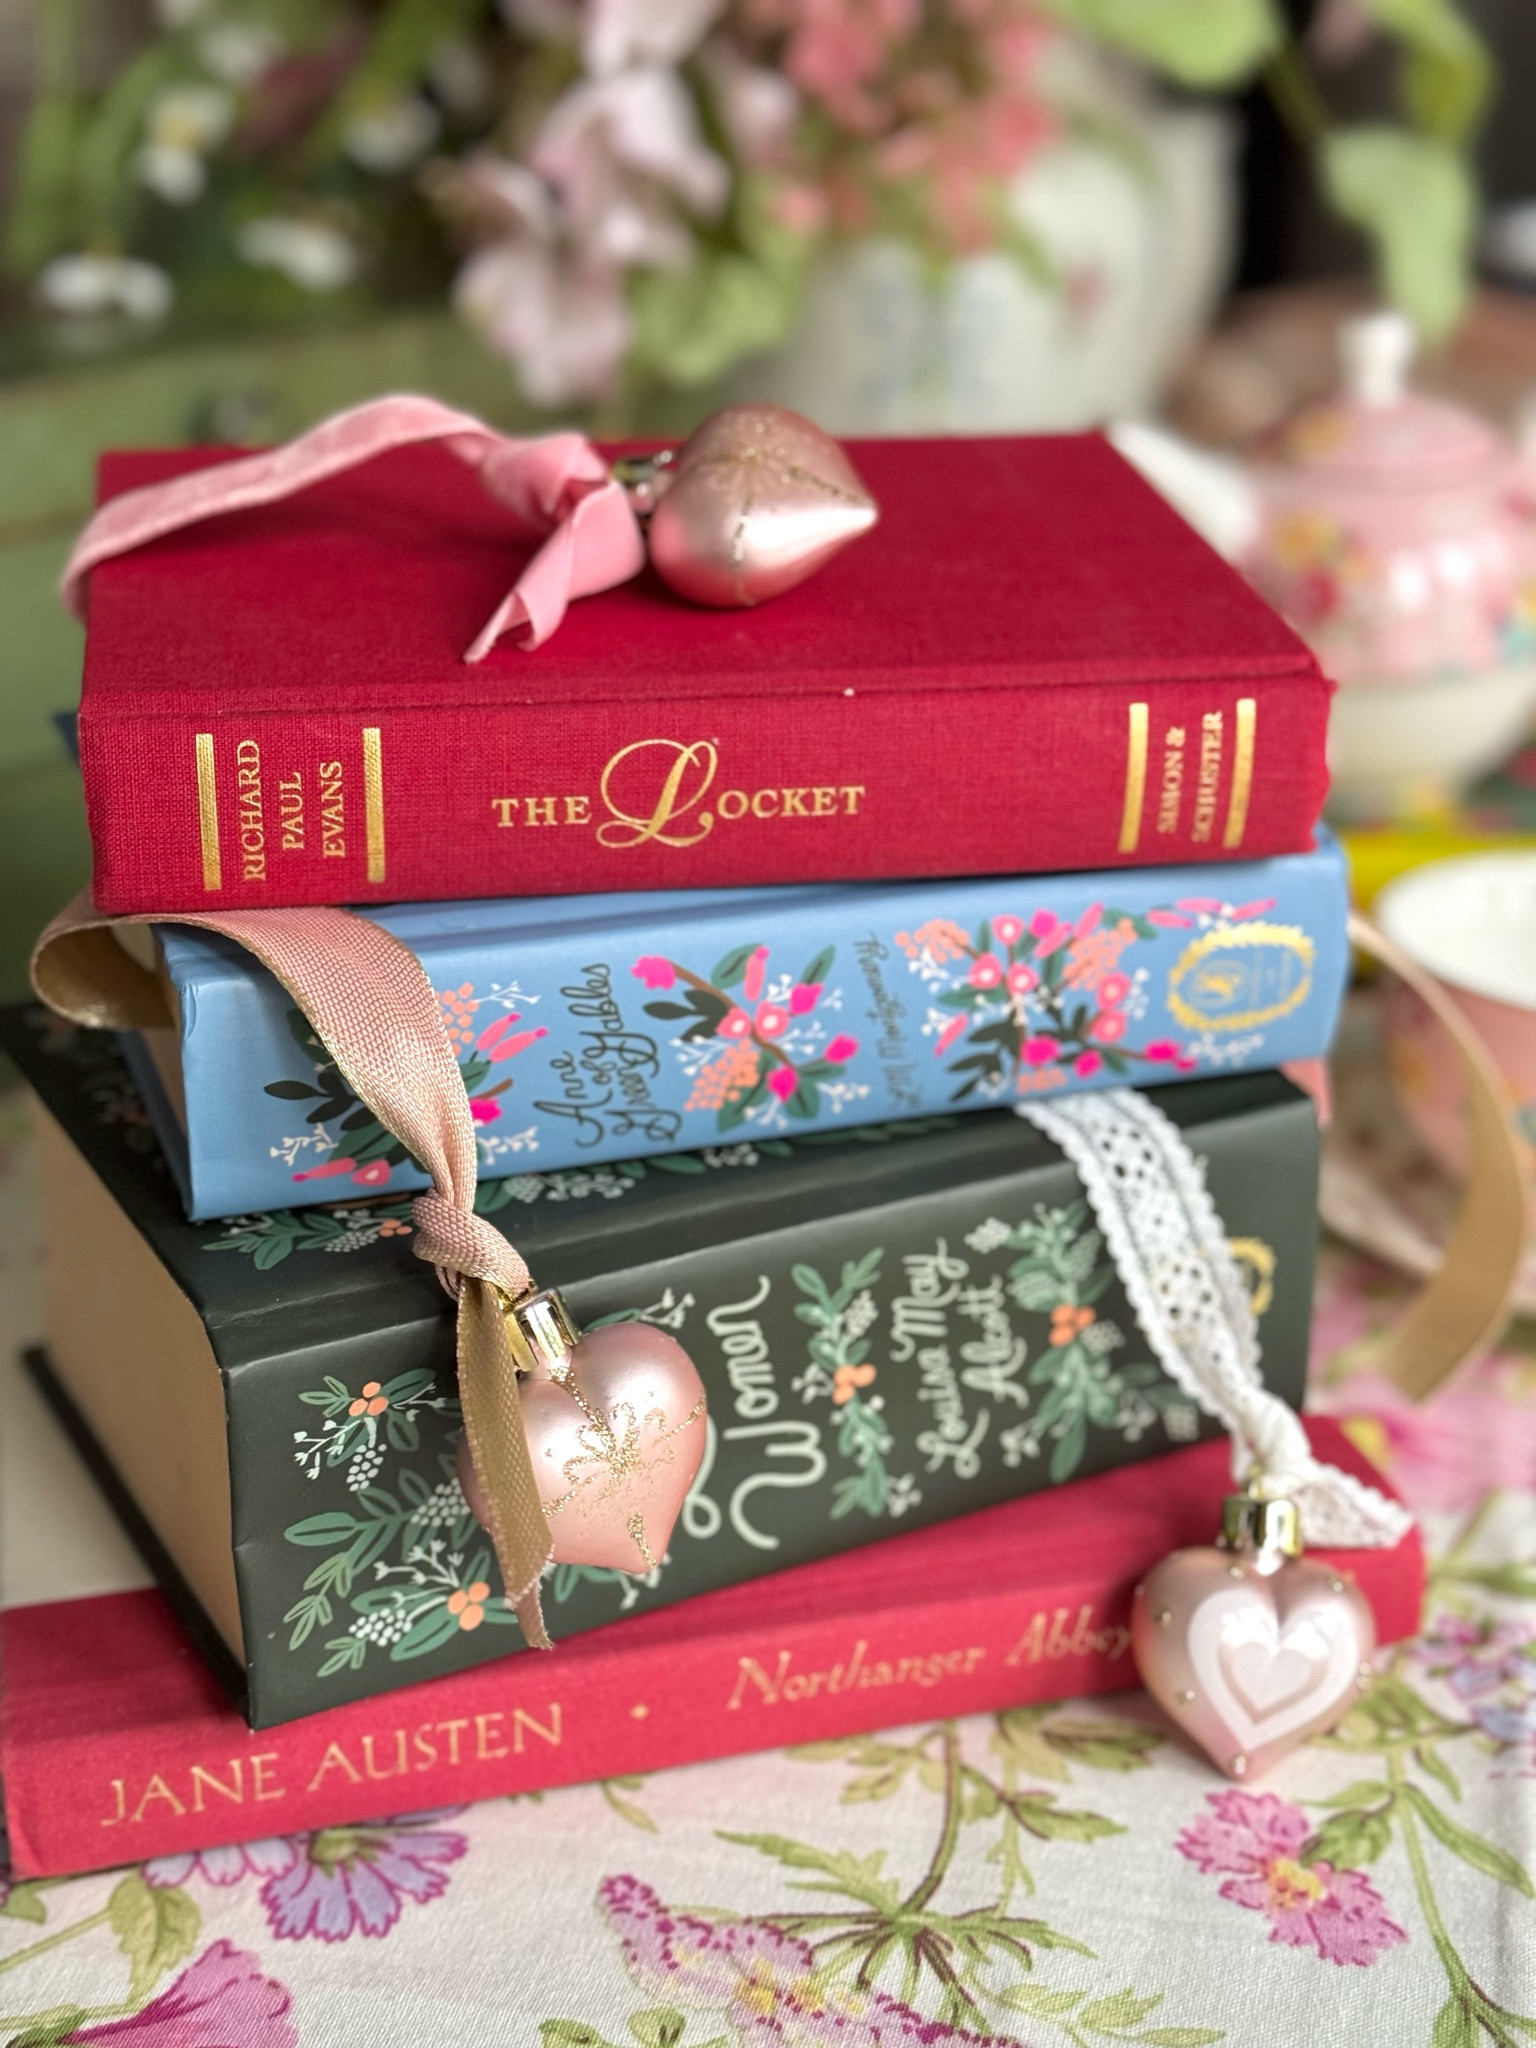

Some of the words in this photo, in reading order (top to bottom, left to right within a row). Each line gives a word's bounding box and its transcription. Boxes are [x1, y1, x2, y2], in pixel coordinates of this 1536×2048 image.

[1165, 726, 1187, 748] &
[1190, 711, 1224, 843] SCHUSTER
[236, 739, 266, 881] RICHARD
[279, 771, 305, 851] PAUL
[319, 760, 346, 859] EVANS
[491, 795, 593, 828] THE
[1156, 750, 1185, 834] SIMON
[559, 963, 660, 1079] Gables
[579, 1059, 618, 1086] of
[532, 1050, 613, 1149] Anne
[603, 1061, 683, 1143] Green
[888, 1236, 970, 1363] May
[956, 1273, 1031, 1411] Alcott
[706, 1274, 828, 1550] Women
[915, 1344, 991, 1480] Louisa
[101, 1752, 287, 1827] JANE
[306, 1702, 564, 1792] AUSTEN
[726, 1638, 988, 1712] Northanger
